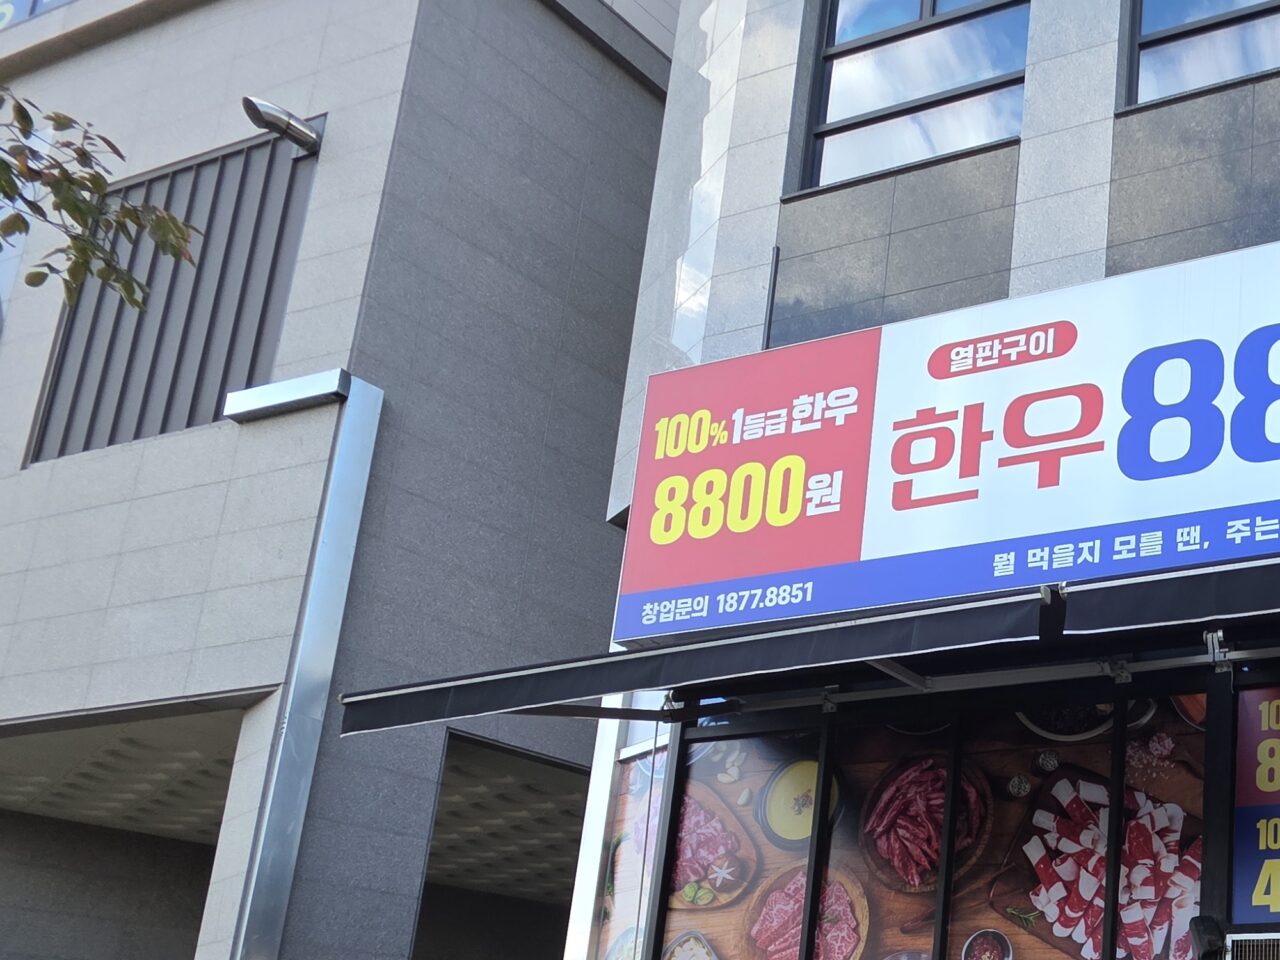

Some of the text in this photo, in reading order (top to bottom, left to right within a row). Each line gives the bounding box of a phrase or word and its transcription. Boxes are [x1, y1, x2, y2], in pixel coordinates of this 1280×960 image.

[949, 328, 1054, 373] 열판구이
[654, 385, 859, 459] 100% 1등급 한우
[650, 455, 843, 545] 8800원
[992, 552, 1015, 577] 뭘
[1026, 537, 1102, 571] 먹을지
[1112, 531, 1163, 562] 모를
[1175, 524, 1210, 553] 땐,
[1226, 516, 1280, 544] 주는
[641, 582, 814, 625] 창업문의 1877.8851
